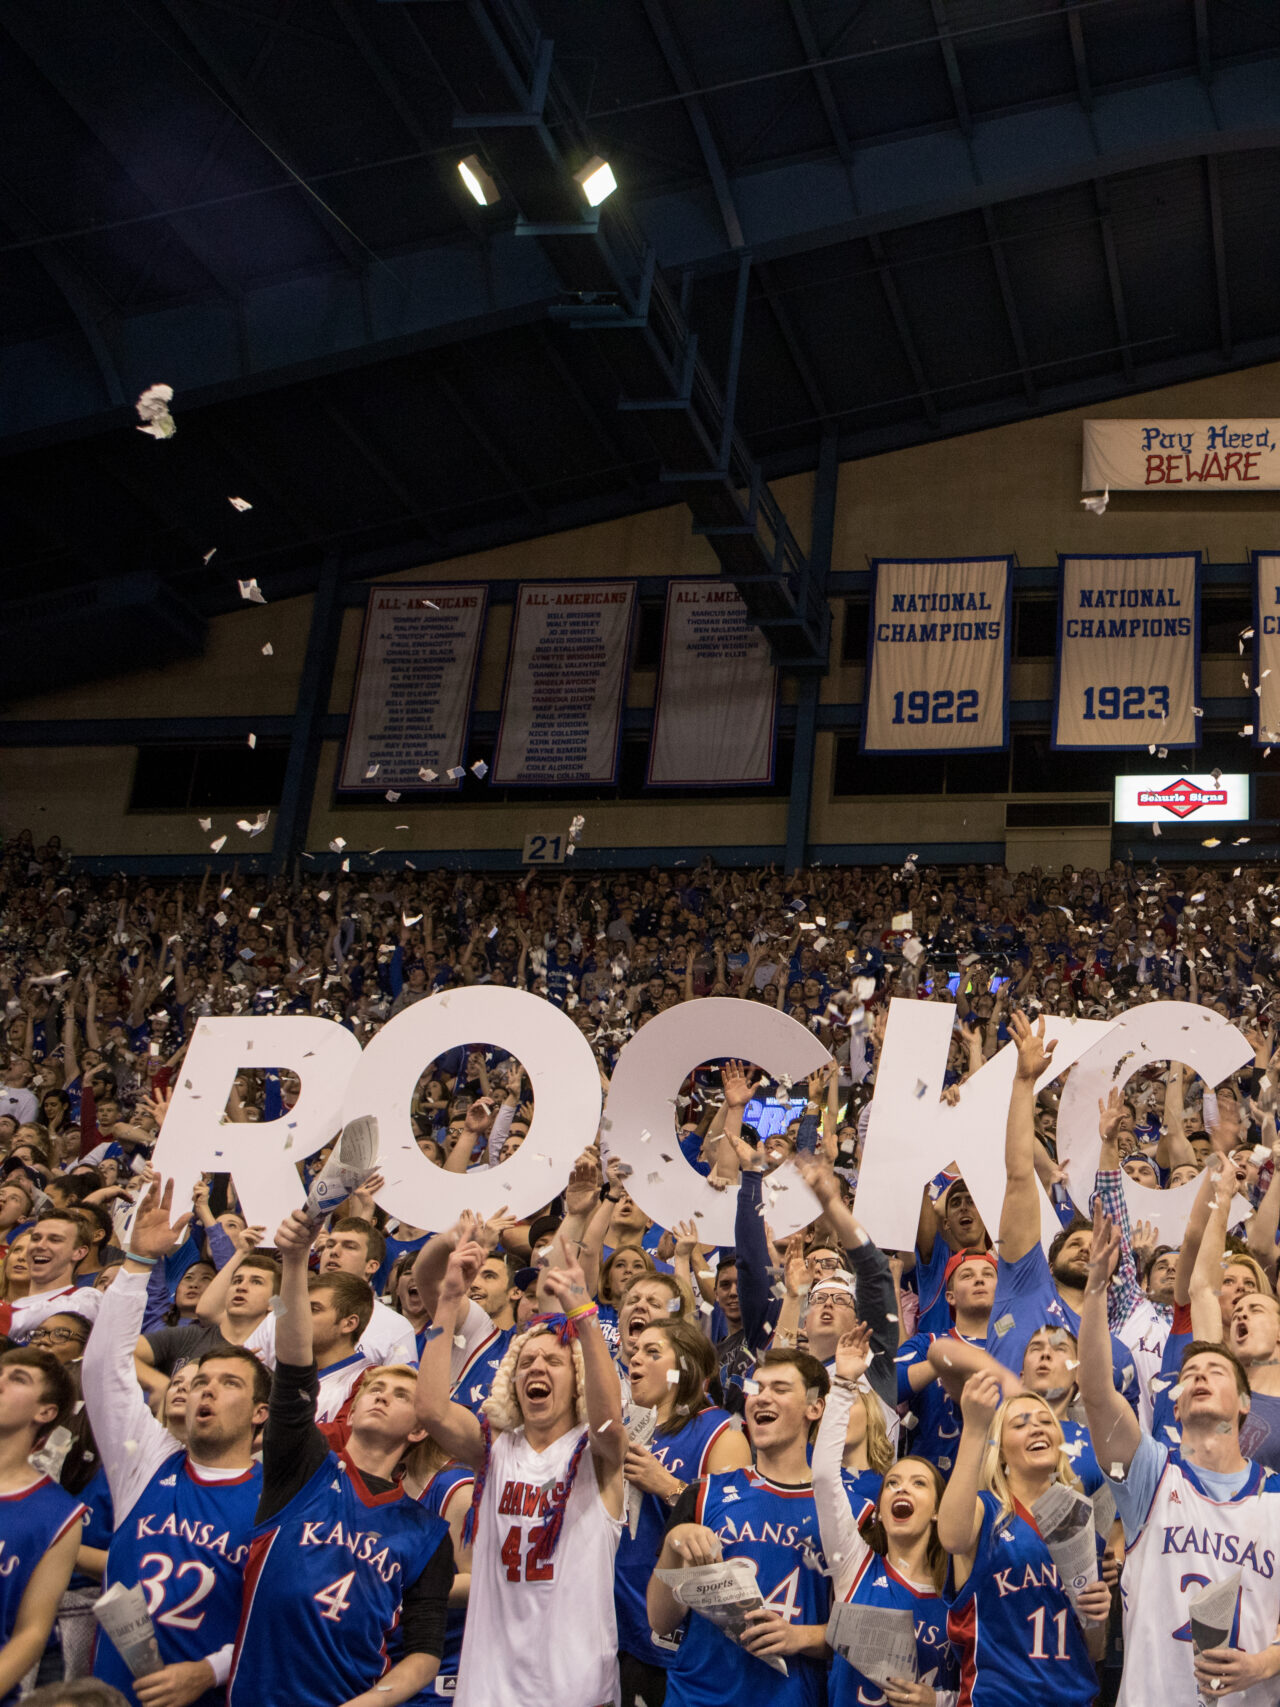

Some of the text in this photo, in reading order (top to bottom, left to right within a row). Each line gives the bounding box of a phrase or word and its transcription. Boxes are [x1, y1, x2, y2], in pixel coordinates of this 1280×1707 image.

[1143, 427, 1194, 454] Pay
[1208, 425, 1275, 453] Heed,
[1145, 451, 1261, 485] BEWARE
[526, 593, 627, 605] ALL-AMERICANS
[677, 592, 743, 603] ALL-AMER
[891, 593, 992, 612] NATIONAL
[1080, 588, 1180, 608] NATIONAL
[877, 622, 1001, 642] CHAMPIONS
[1066, 617, 1191, 638] CHAMPIONS
[892, 689, 979, 725] 1922
[1083, 685, 1170, 720] 1923
[1189, 792, 1224, 804] Signs
[529, 836, 561, 860] 21
[136, 1512, 249, 1564] KANSAS
[299, 1521, 401, 1583] KANSAS
[501, 1526, 554, 1582] 42
[1162, 1525, 1275, 1580] KANSAS
[139, 1552, 216, 1631] 32
[313, 1570, 356, 1622] 4
[696, 1579, 733, 1593] sports
[993, 1562, 1065, 1597] KAN
[1027, 1605, 1071, 1661] 11
